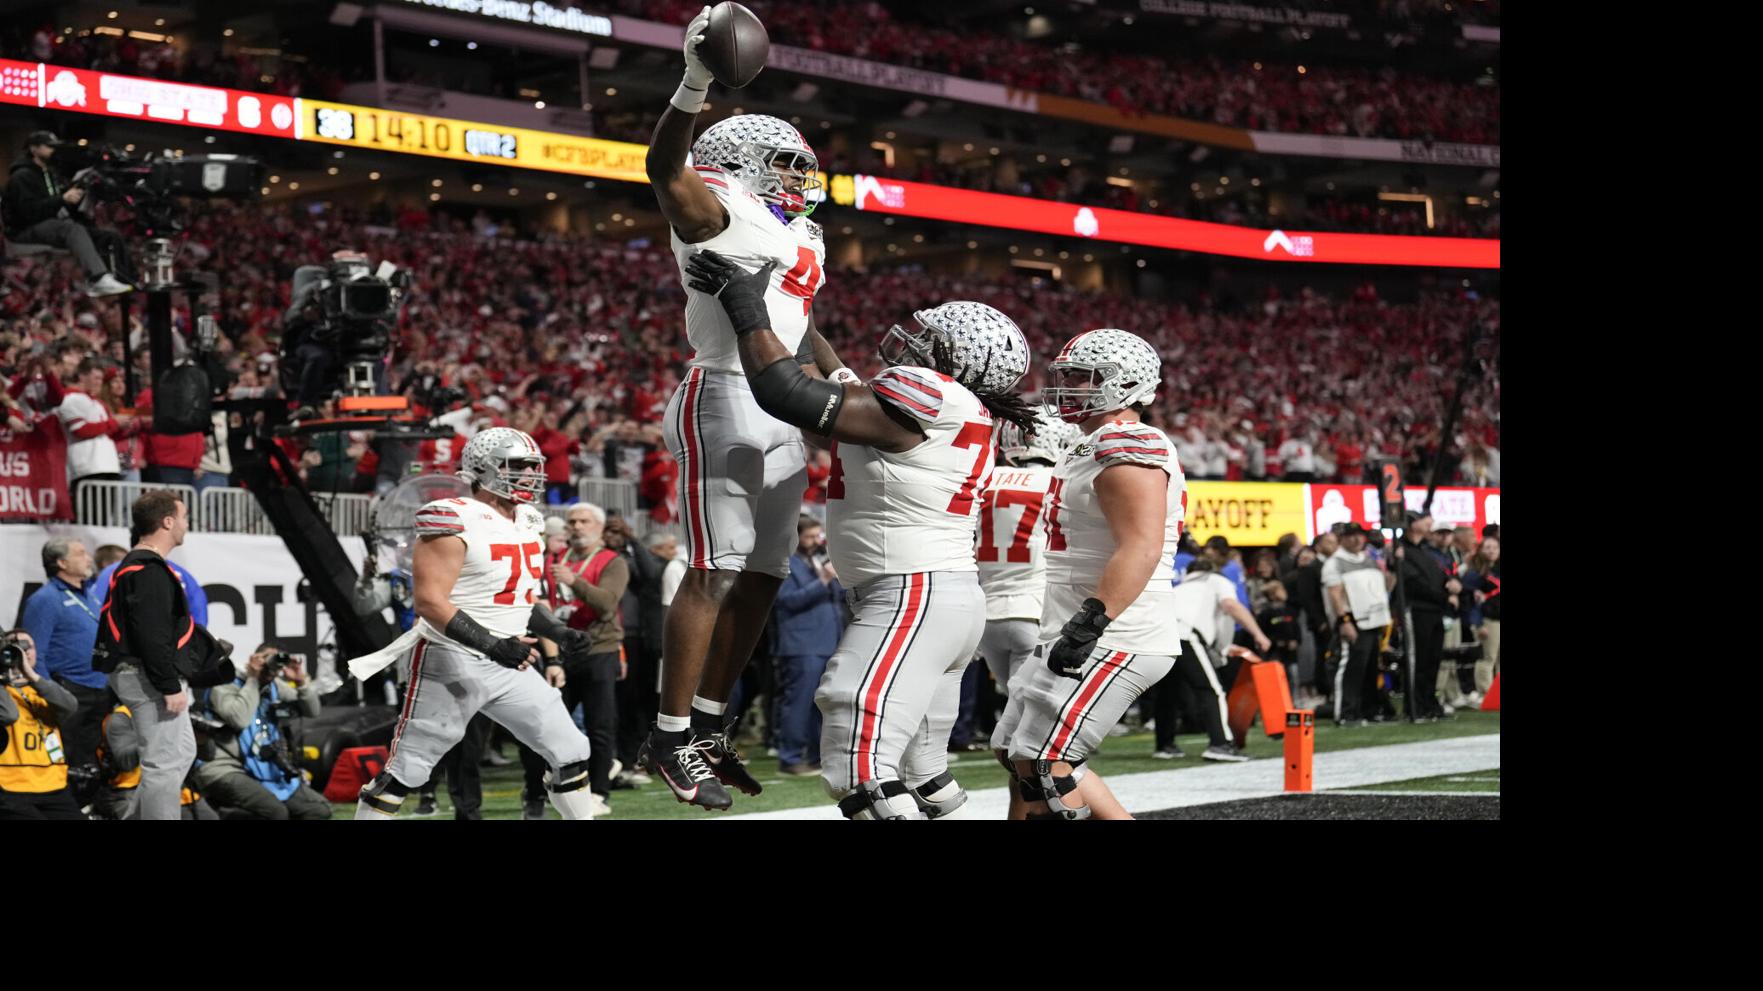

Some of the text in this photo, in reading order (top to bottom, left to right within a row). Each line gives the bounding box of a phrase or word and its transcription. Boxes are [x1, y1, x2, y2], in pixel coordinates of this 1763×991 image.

[369, 113, 451, 152] 14:10
[780, 246, 821, 316] 4
[946, 421, 999, 516] 7
[995, 472, 1033, 487] TATE
[1383, 463, 1401, 502] 2
[0, 484, 57, 515] ORLD
[1184, 498, 1274, 530] AYOFF
[977, 489, 1044, 563] 17
[489, 541, 542, 605] 75
